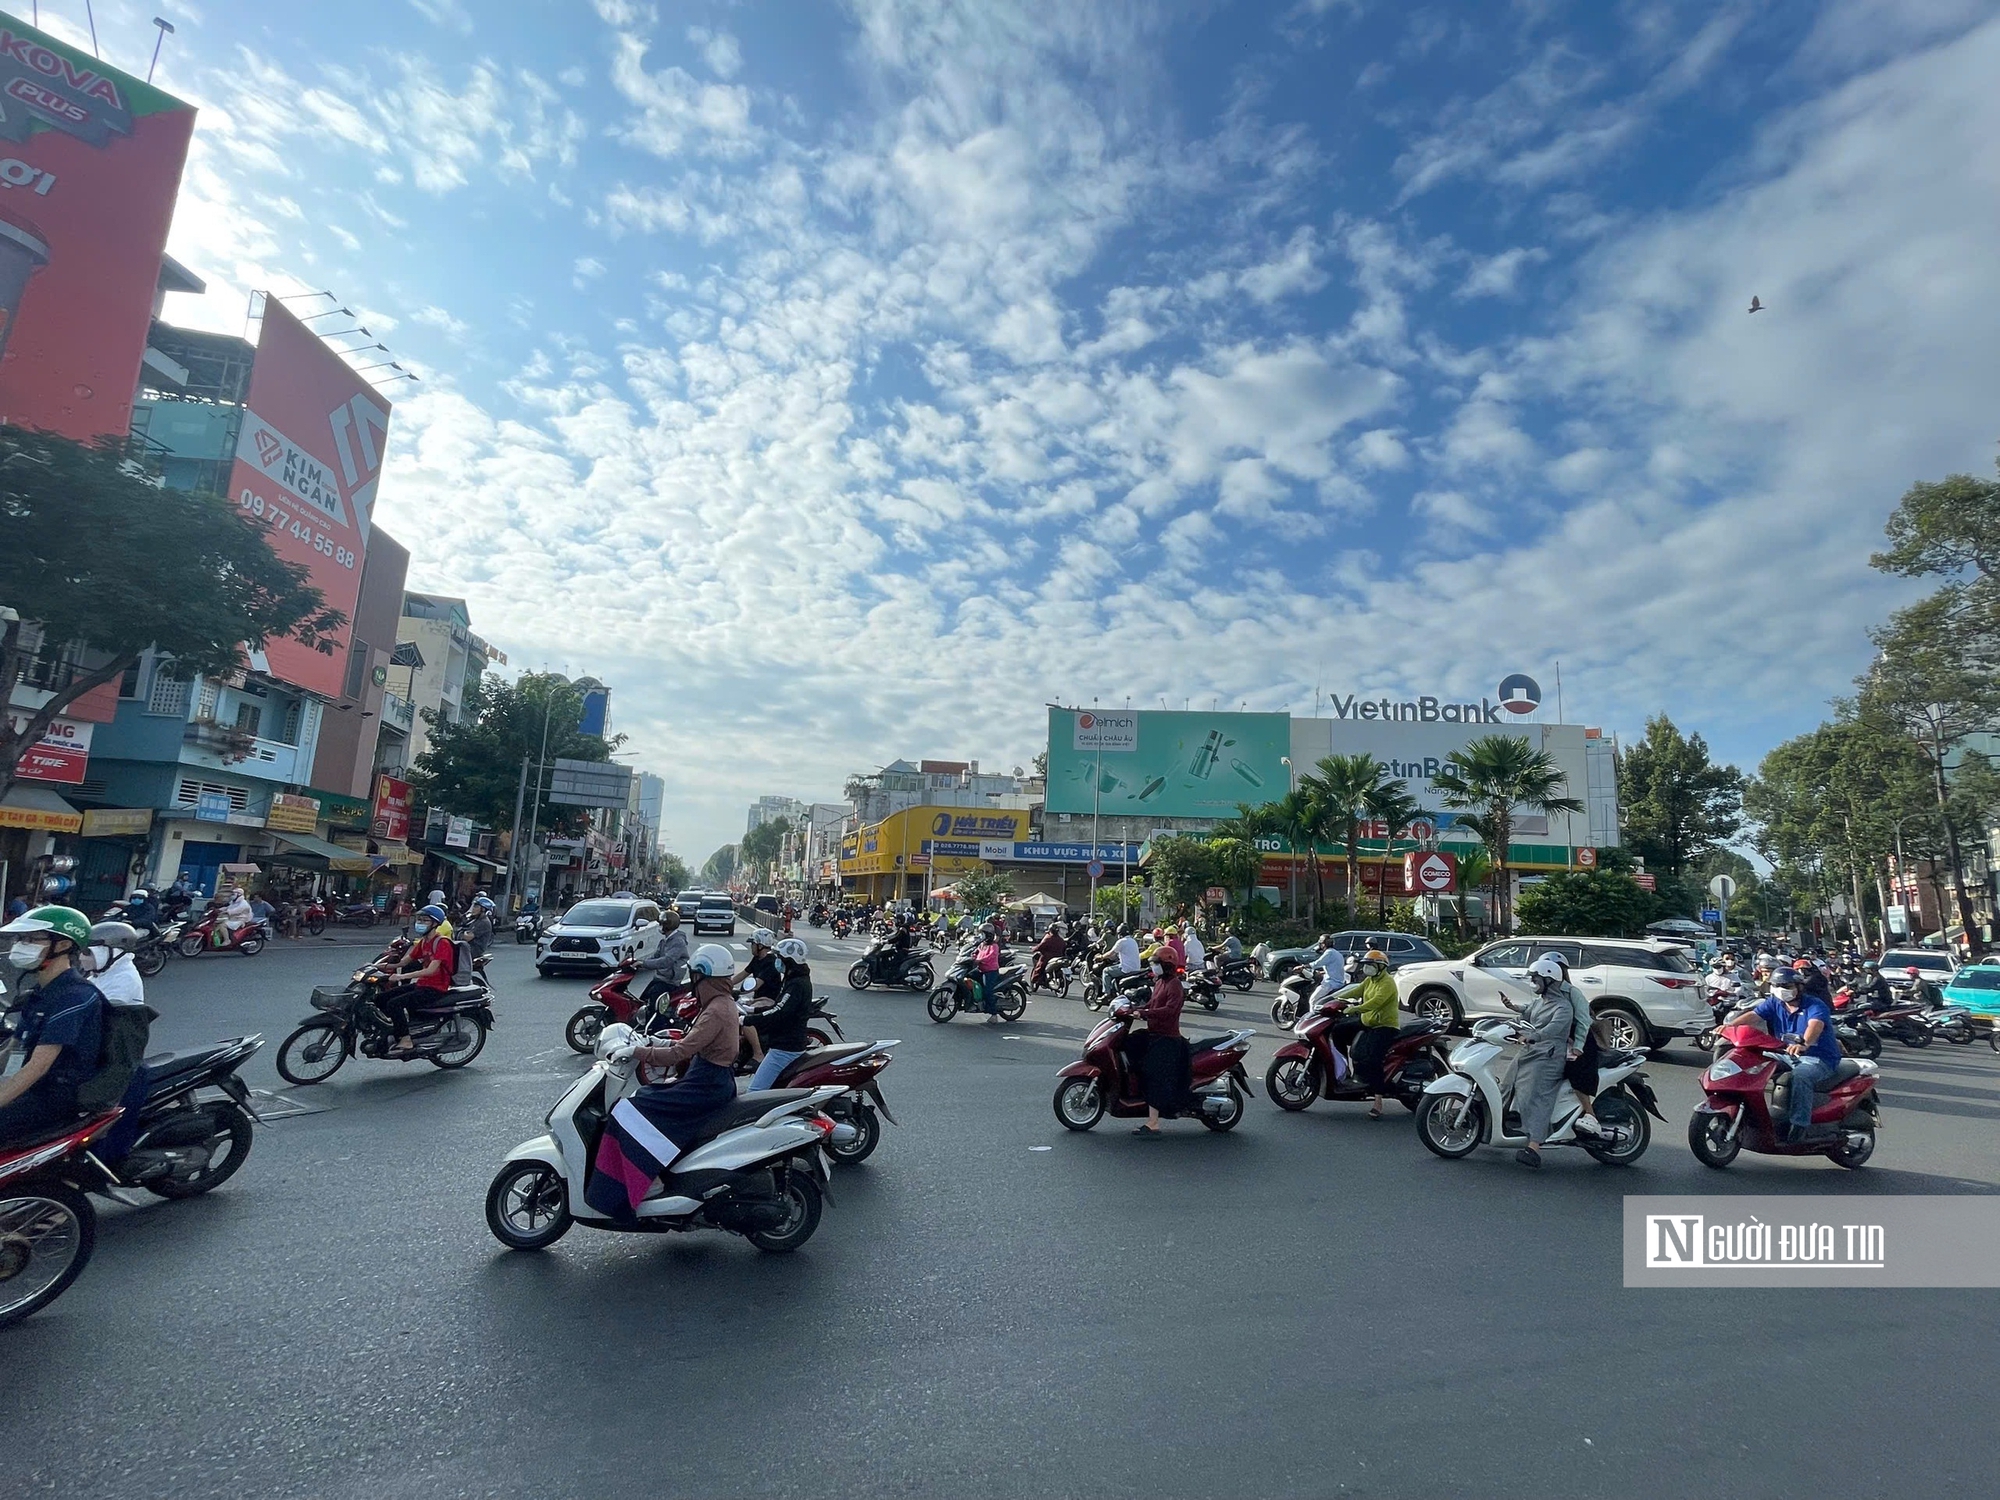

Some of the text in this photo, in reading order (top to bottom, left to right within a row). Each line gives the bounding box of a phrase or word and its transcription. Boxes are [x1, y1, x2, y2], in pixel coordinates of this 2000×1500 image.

[1, 29, 123, 110] KOVA
[286, 448, 322, 485] KIM
[241, 488, 355, 570] 09 77 44 55 88
[1330, 693, 1502, 724] VietinBank
[985, 846, 1007, 854] Mobil
[1023, 846, 1050, 855] KHU
[1053, 847, 1078, 858] VỰC
[1254, 839, 1281, 850] TRO
[1422, 870, 1451, 878] COMECO
[63, 921, 86, 938] Grab
